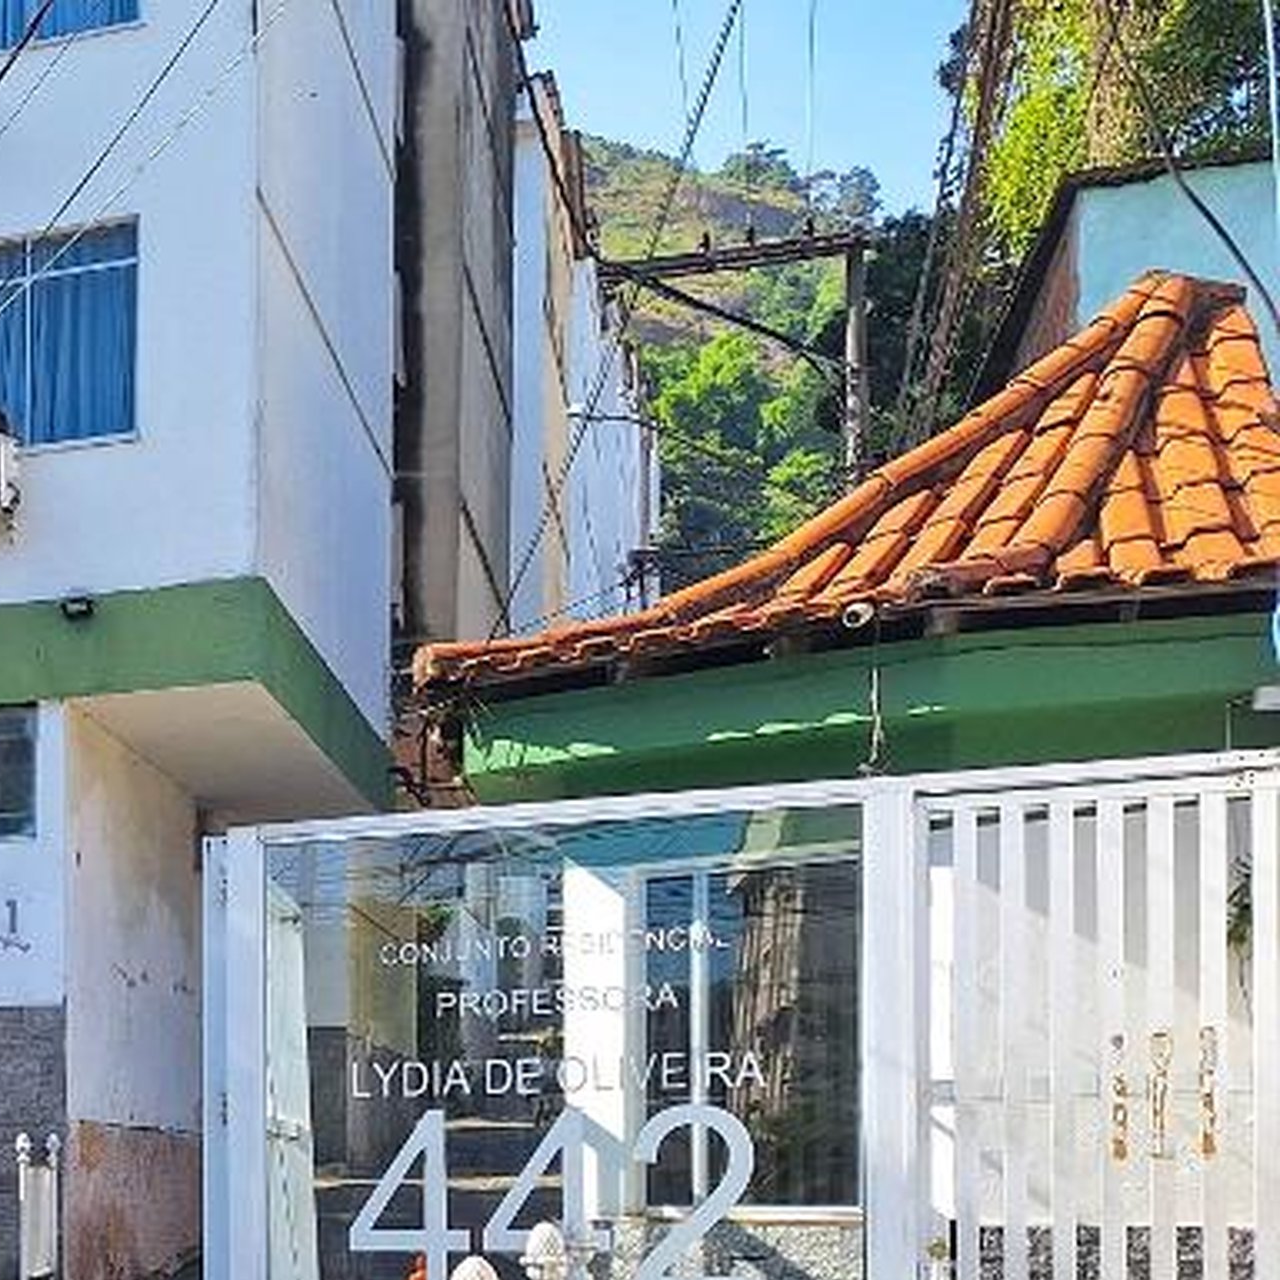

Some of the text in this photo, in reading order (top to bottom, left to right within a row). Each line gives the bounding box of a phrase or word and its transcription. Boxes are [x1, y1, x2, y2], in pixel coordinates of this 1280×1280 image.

[378, 925, 731, 967] CONJUNTO RSIDENCAL
[435, 982, 680, 1019] PROFESSORA
[351, 1051, 766, 1099] LYDIA DE OLIVERA
